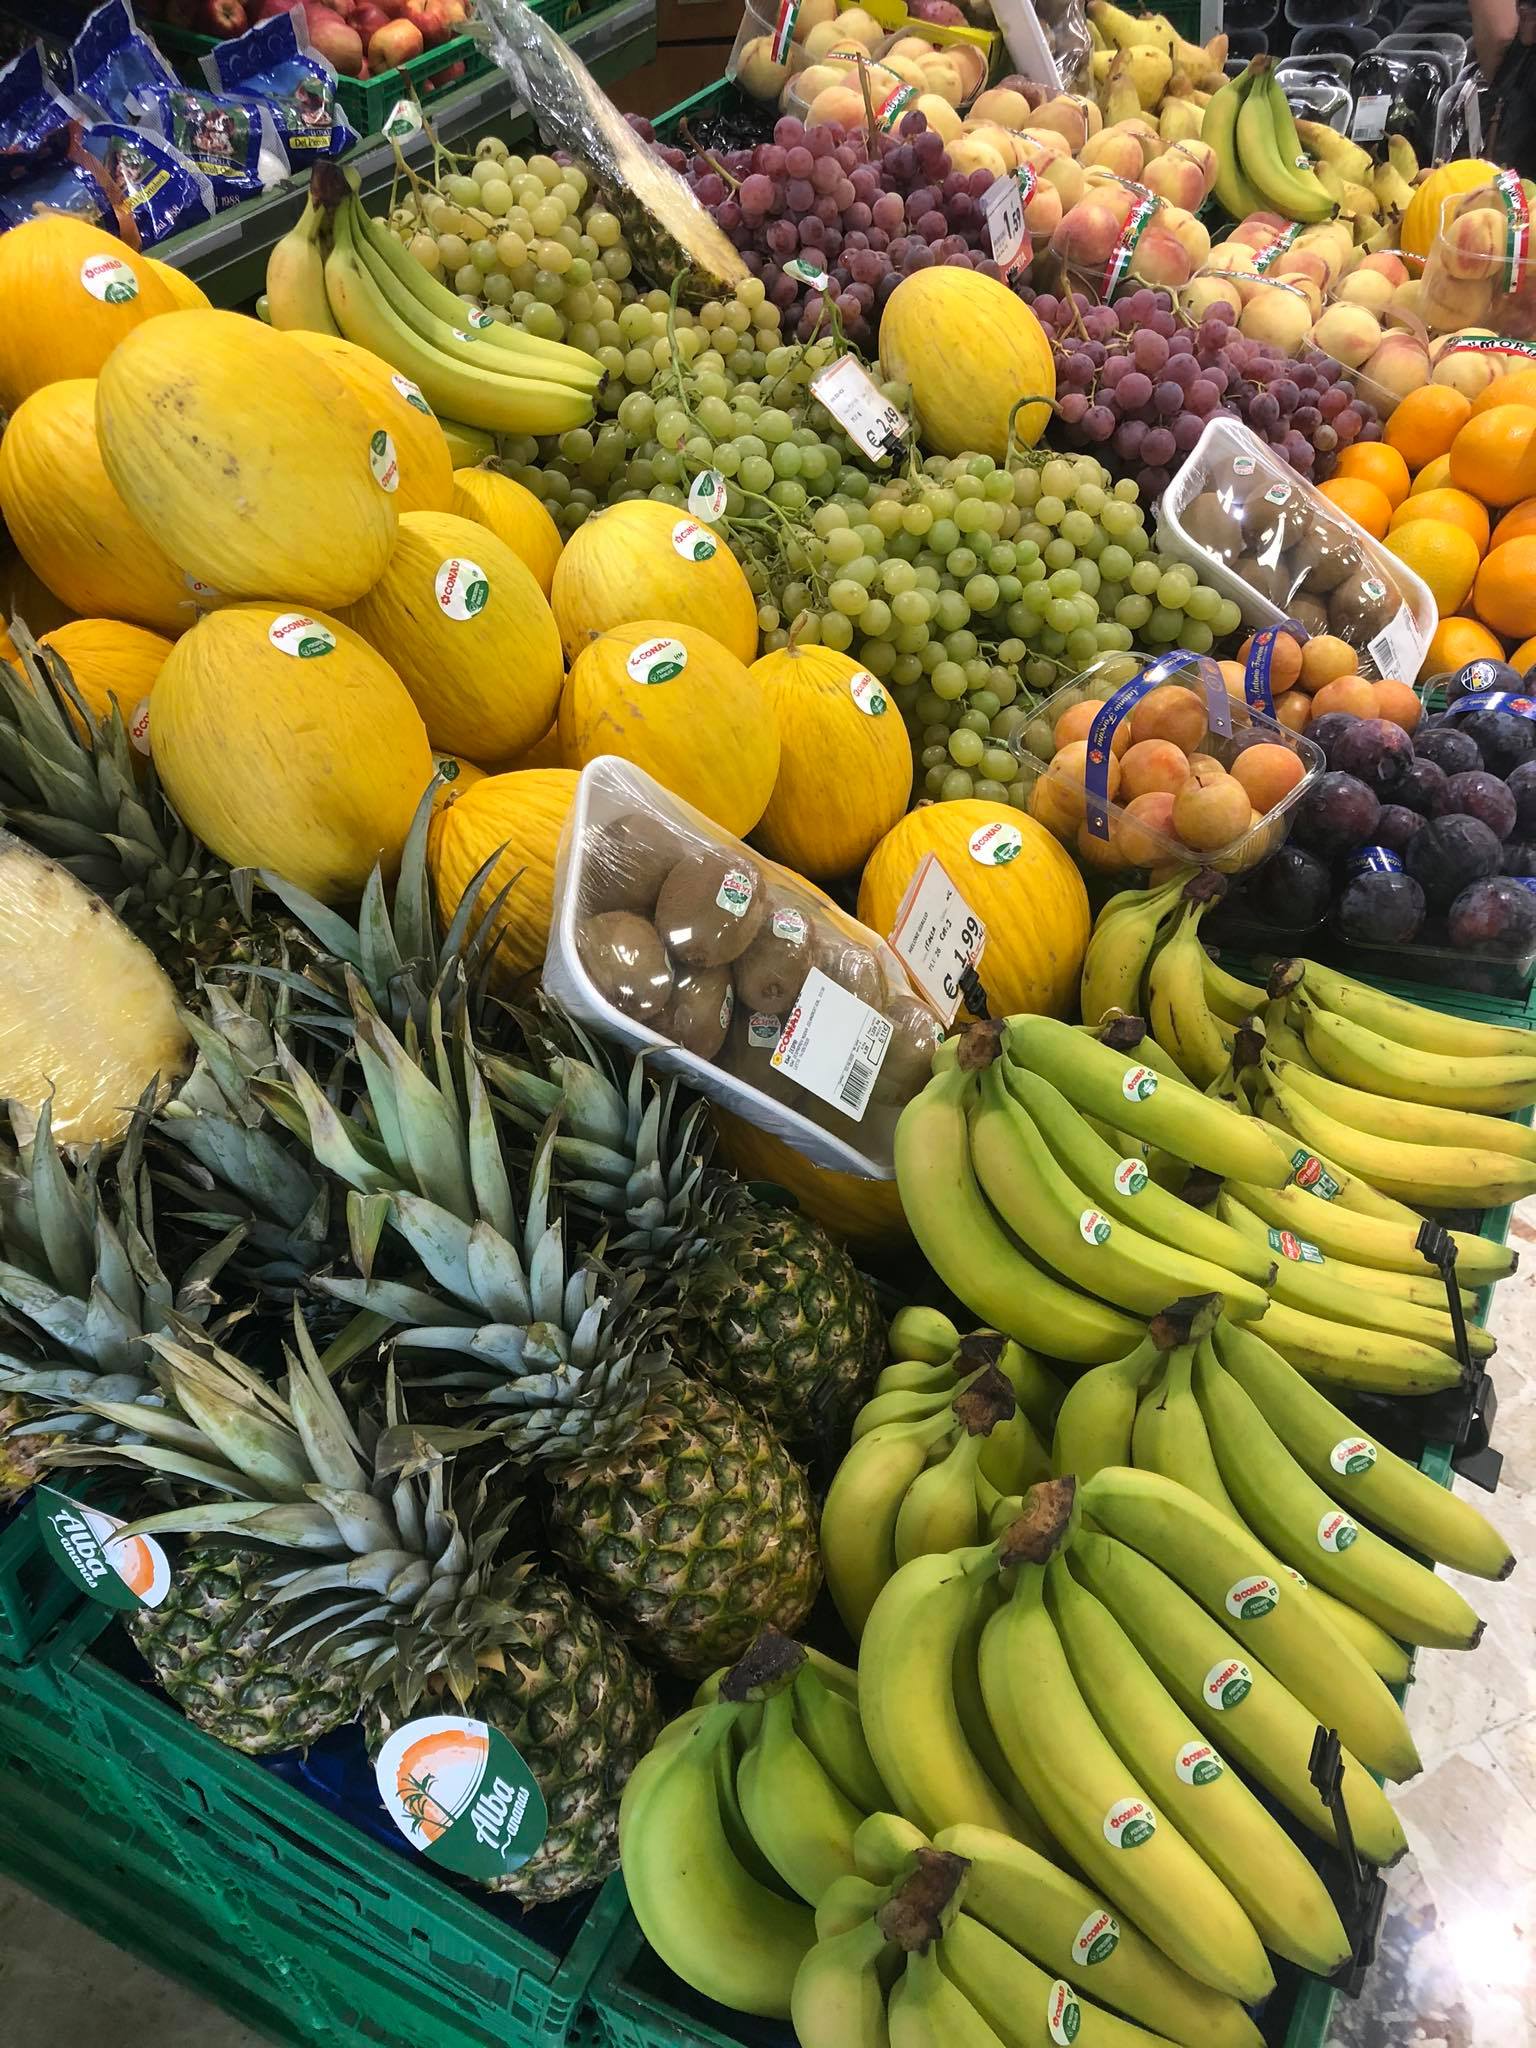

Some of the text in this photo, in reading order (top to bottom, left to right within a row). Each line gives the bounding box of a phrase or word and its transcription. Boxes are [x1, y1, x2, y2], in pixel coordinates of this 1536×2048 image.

[445, 561, 460, 595] CONAD
[282, 619, 313, 633] CONAD
[978, 824, 1002, 846] CONAD
[943, 916, 979, 1000] € 1,99
[778, 1008, 802, 1054] CONAD
[55, 1509, 108, 1578] Alba
[56, 1530, 98, 1588] ananas
[1241, 1580, 1269, 1599] CONAD
[1269, 1587, 1278, 1597] ET
[1215, 1663, 1239, 1687] CONAD
[1241, 1667, 1249, 1677] ET
[1189, 1747, 1212, 1762] CONAD
[471, 1776, 515, 1850] Alba
[504, 1786, 530, 1845] ananas
[1118, 1803, 1144, 1823] CONAD
[1086, 1913, 1109, 1942] CONAD
[1055, 1985, 1065, 2018] CONAD
